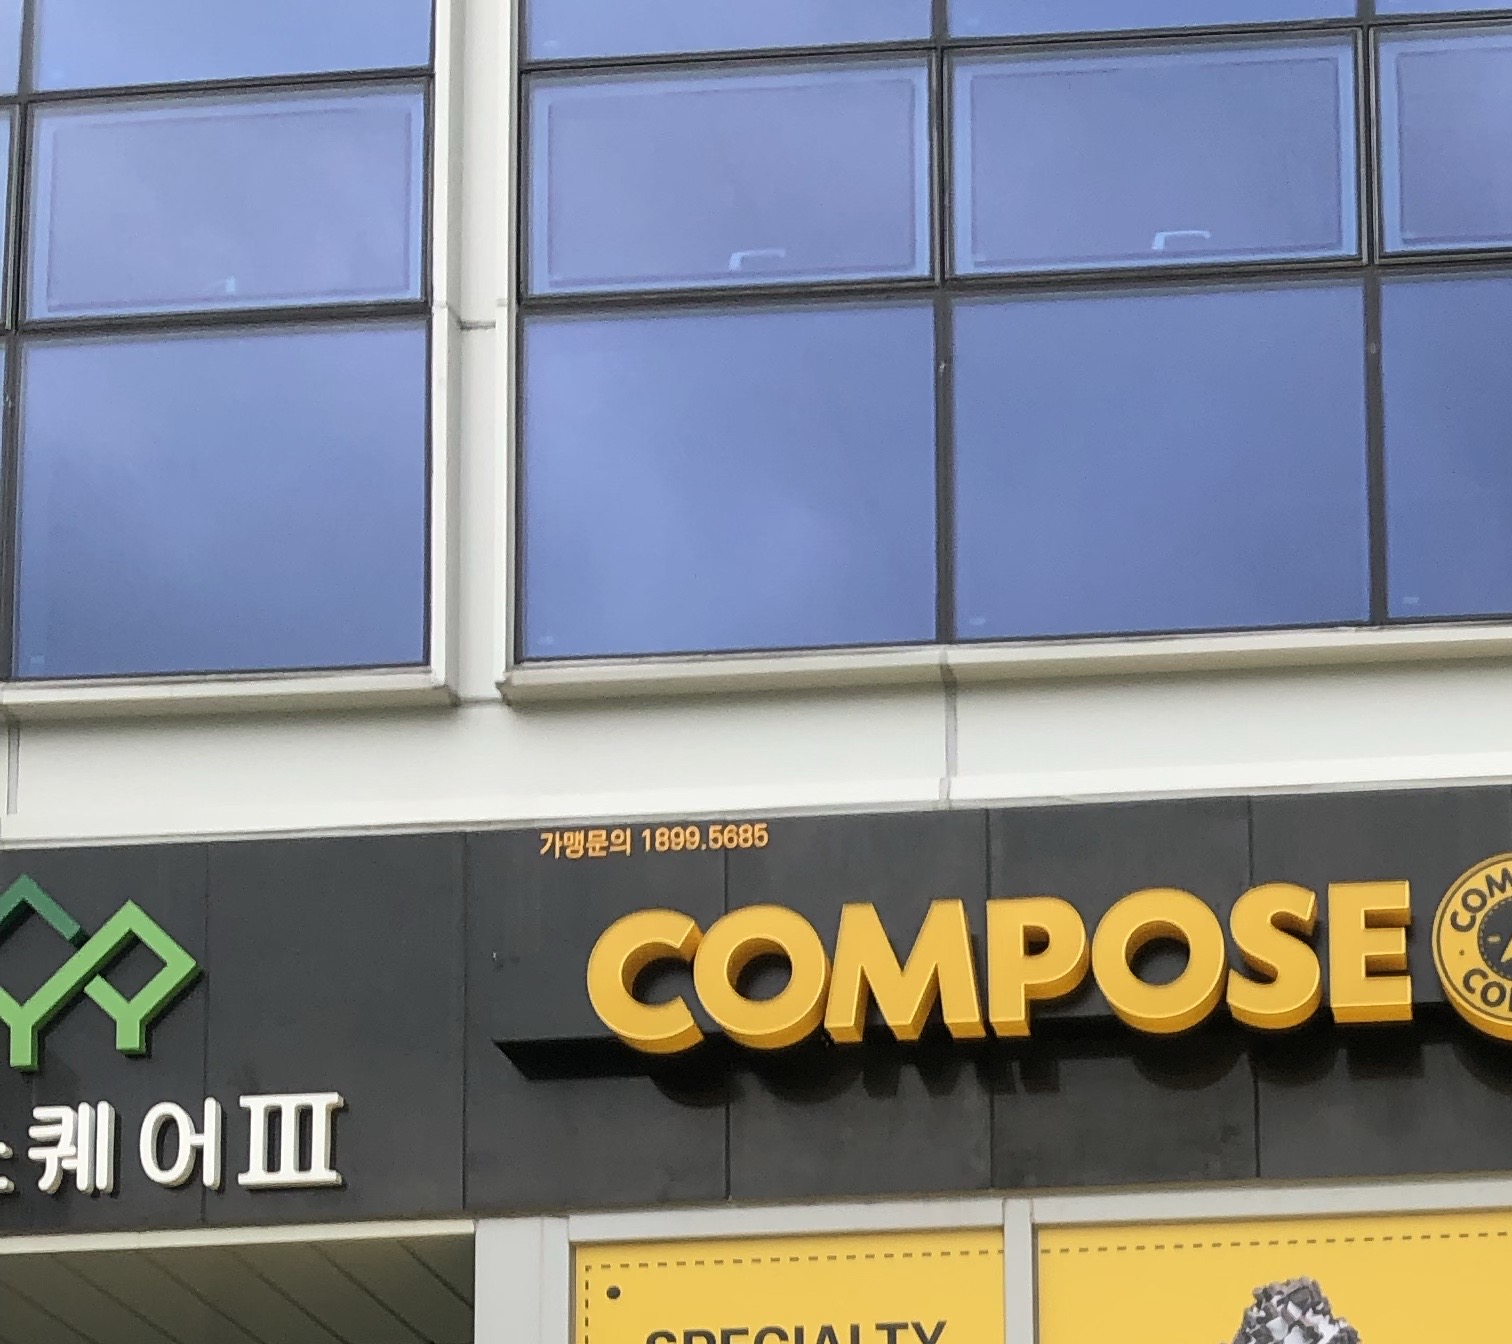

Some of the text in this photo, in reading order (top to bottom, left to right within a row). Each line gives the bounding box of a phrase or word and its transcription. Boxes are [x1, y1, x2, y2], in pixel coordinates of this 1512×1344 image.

[540, 823, 769, 860] 가맹문의 1899.5685
[586, 882, 1413, 1053] COMPOSE
